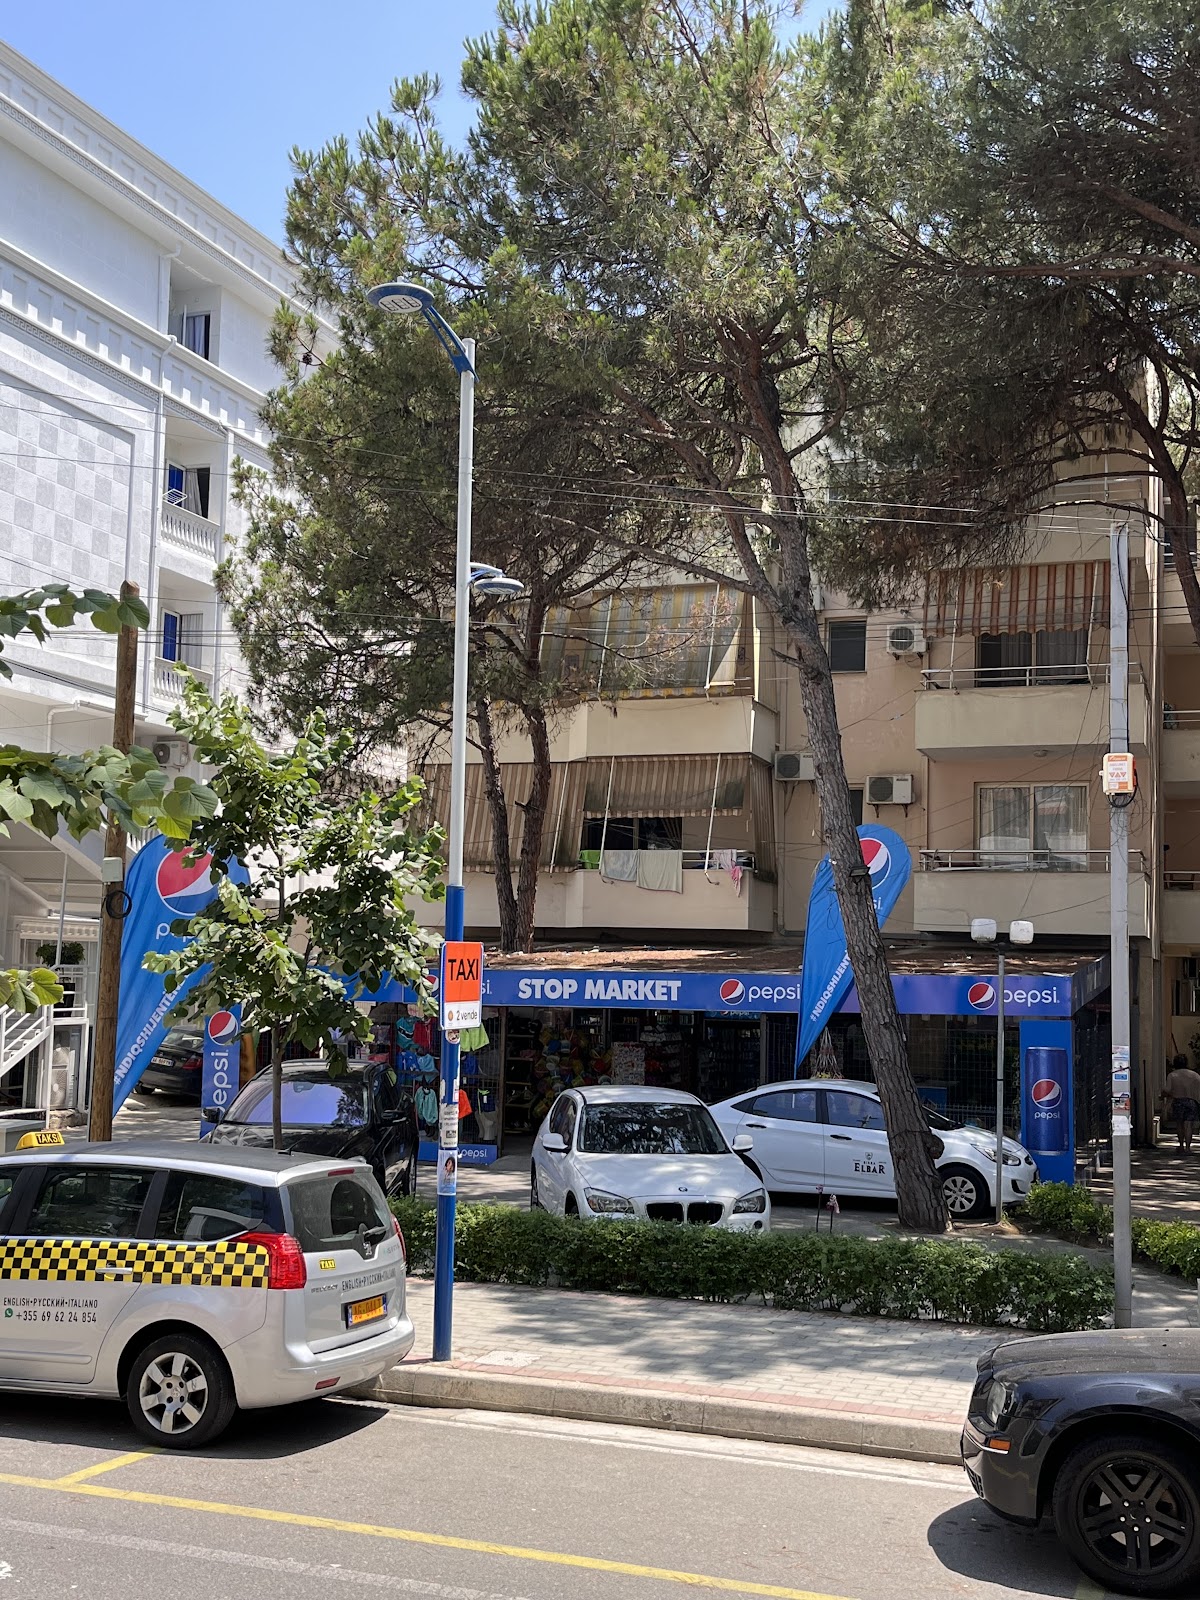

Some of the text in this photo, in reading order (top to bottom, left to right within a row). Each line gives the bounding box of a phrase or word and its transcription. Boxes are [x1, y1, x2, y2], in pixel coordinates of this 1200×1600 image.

[448, 959, 479, 981] TAXI
[518, 978, 578, 999] STOP
[584, 979, 682, 1001] MARKET
[748, 983, 800, 1003] pepsi
[809, 949, 851, 1022] #NDIQSHIJENT
[210, 1049, 232, 1114] epsi
[1034, 1111, 1061, 1120] pepsi
[854, 1162, 885, 1174] ELBAR
[320, 1259, 335, 1269] TAXI
[16, 1311, 97, 1322] +355 69 62 24 854
